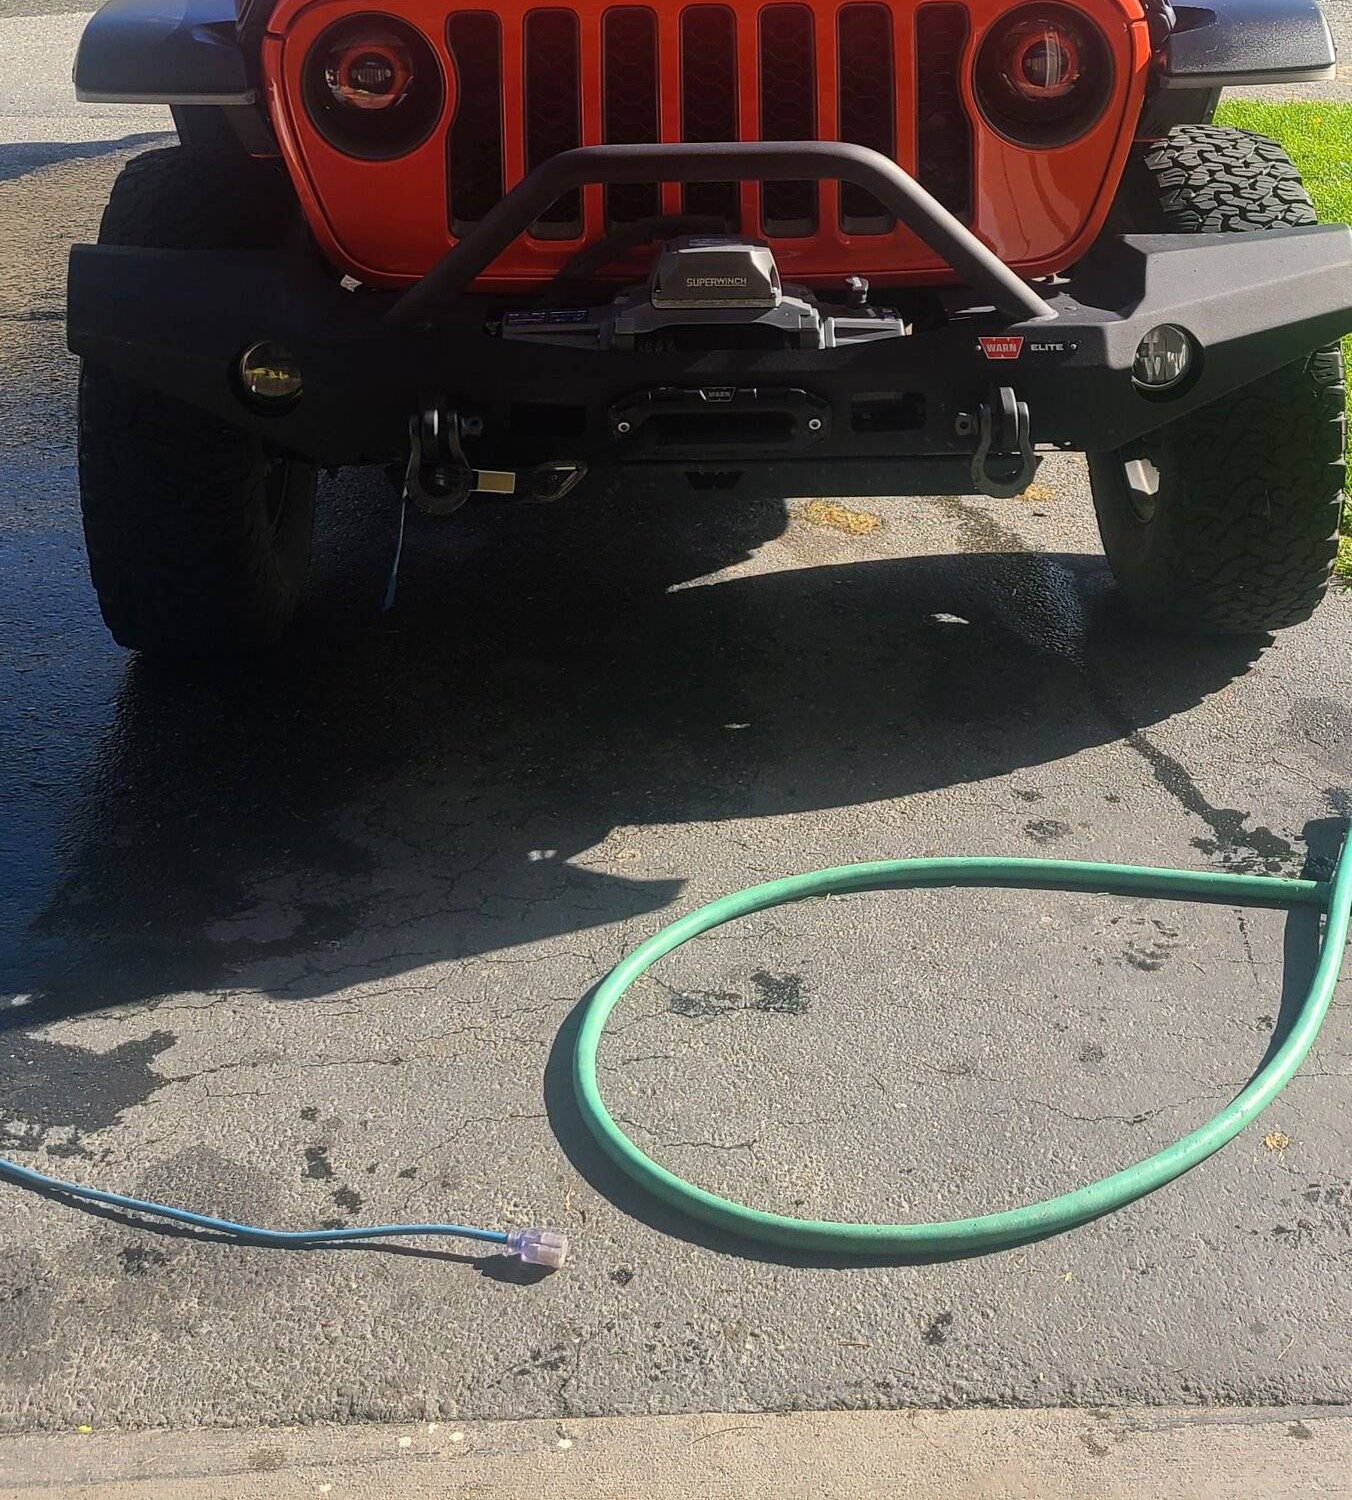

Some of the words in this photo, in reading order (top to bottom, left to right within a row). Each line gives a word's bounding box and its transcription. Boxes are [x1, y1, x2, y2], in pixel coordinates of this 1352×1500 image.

[686, 277, 747, 288] SUPERWINCH
[986, 343, 1017, 353] WARN
[1030, 343, 1064, 352] ELITE
